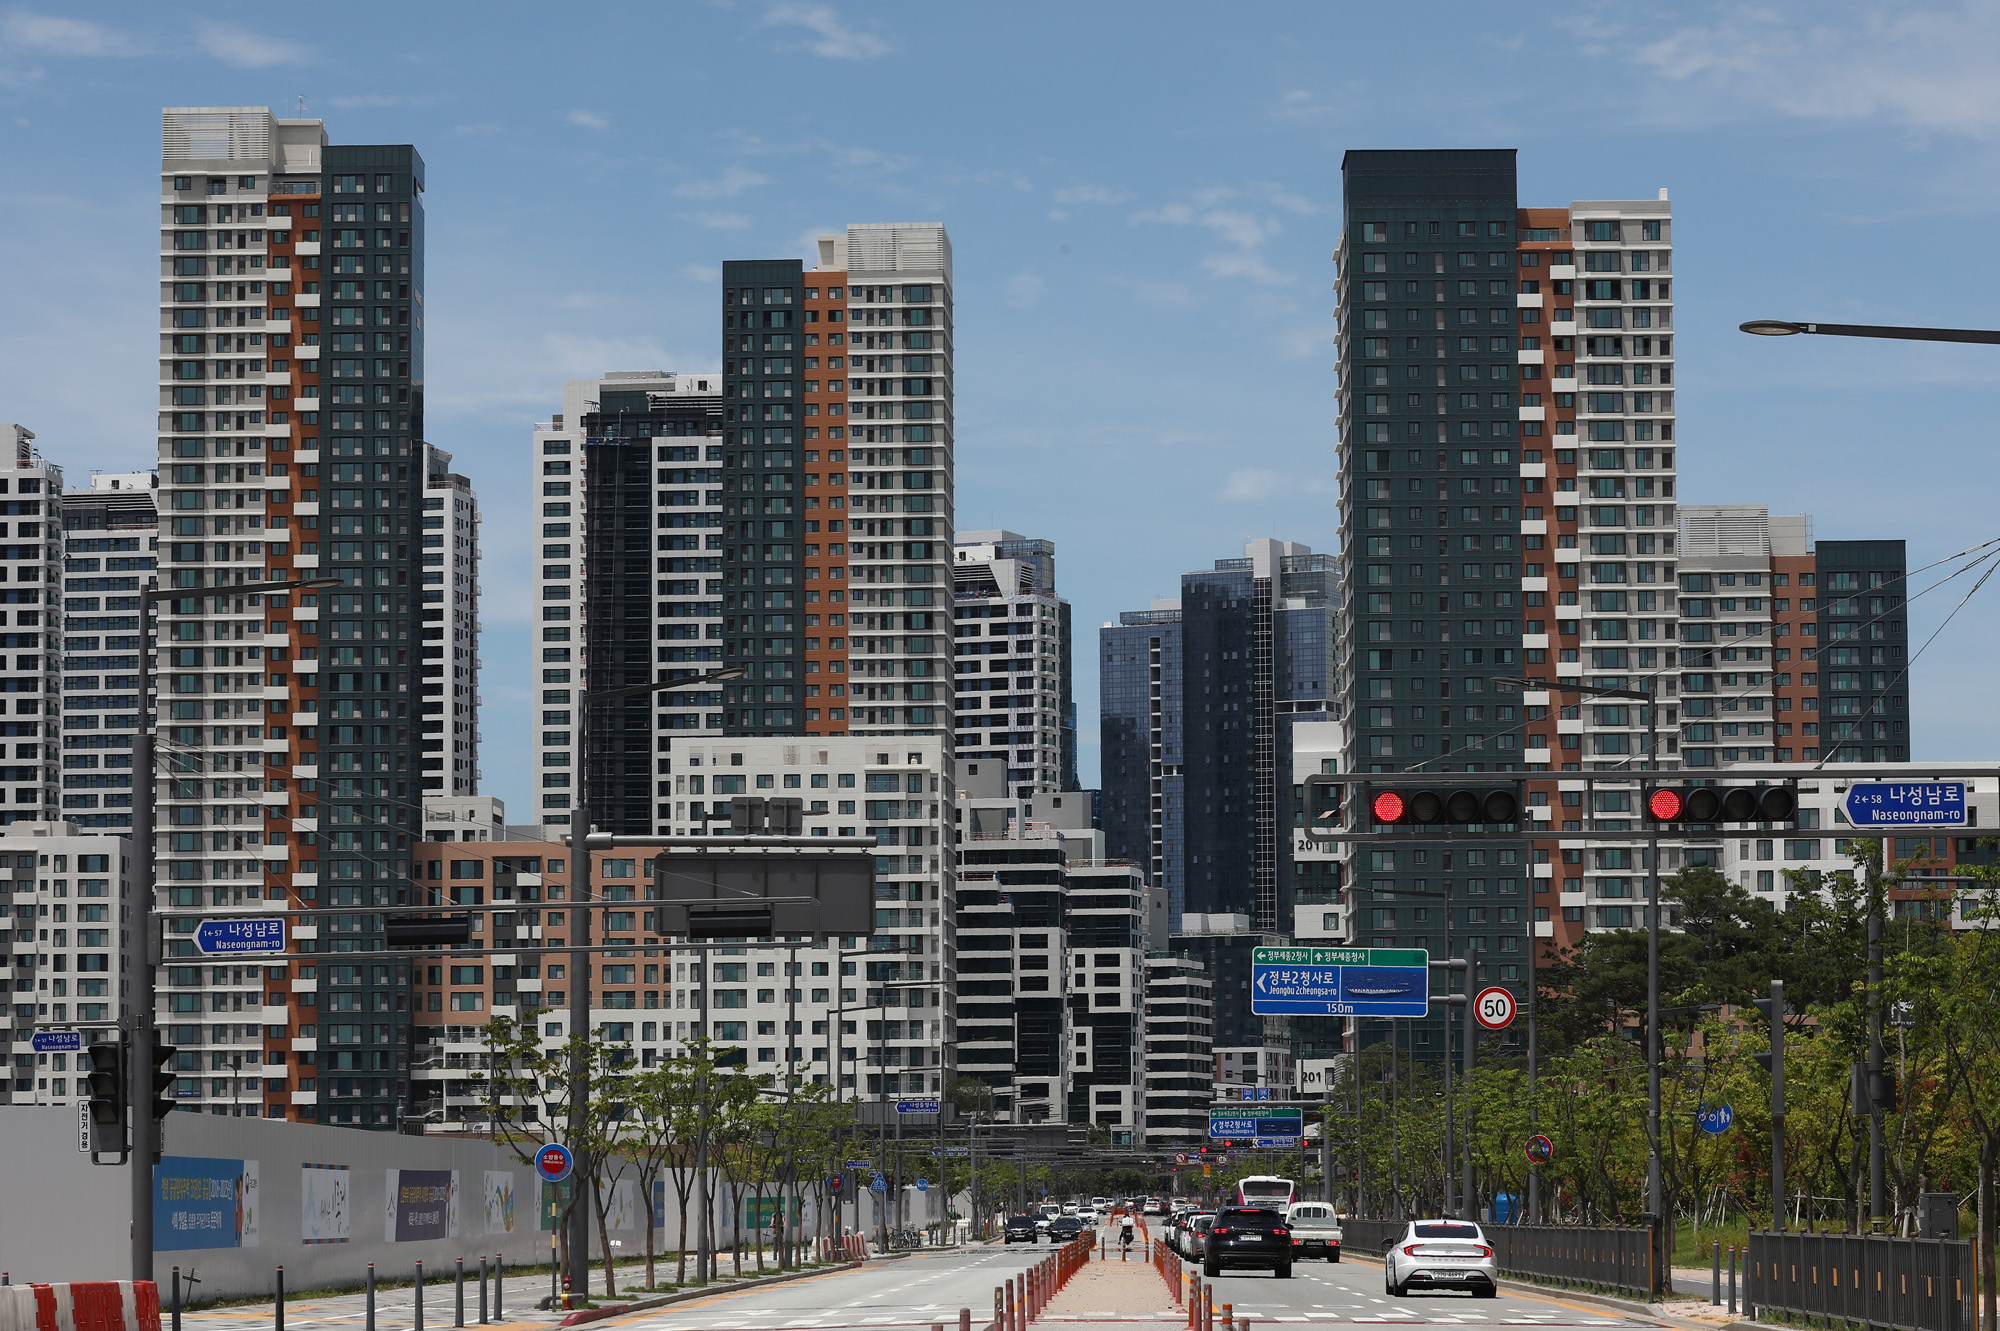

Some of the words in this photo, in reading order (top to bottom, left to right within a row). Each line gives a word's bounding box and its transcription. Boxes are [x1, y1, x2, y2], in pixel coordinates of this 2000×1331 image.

[1890, 785, 1960, 806] 나성남로
[1872, 809, 1960, 822] Naseongnam-ro
[229, 922, 280, 938] 나성남로
[216, 940, 280, 949] Naseongnam-ro
[1267, 951, 1308, 962] 정부세종2청사
[1324, 951, 1366, 962] 정부세종청사
[1269, 970, 1334, 986] 정부2청사로
[1268, 985, 1294, 997] Jeongbu
[1295, 986, 1337, 997] 2cheongsa-ro
[1326, 1003, 1354, 1014] 150m
[1484, 999, 1506, 1017] 50
[48, 1034, 78, 1043] 나성남로
[1302, 1071, 1321, 1082] 201
[1218, 1121, 1252, 1130] 정부2청사로
[81, 1132, 88, 1149] 겸용
